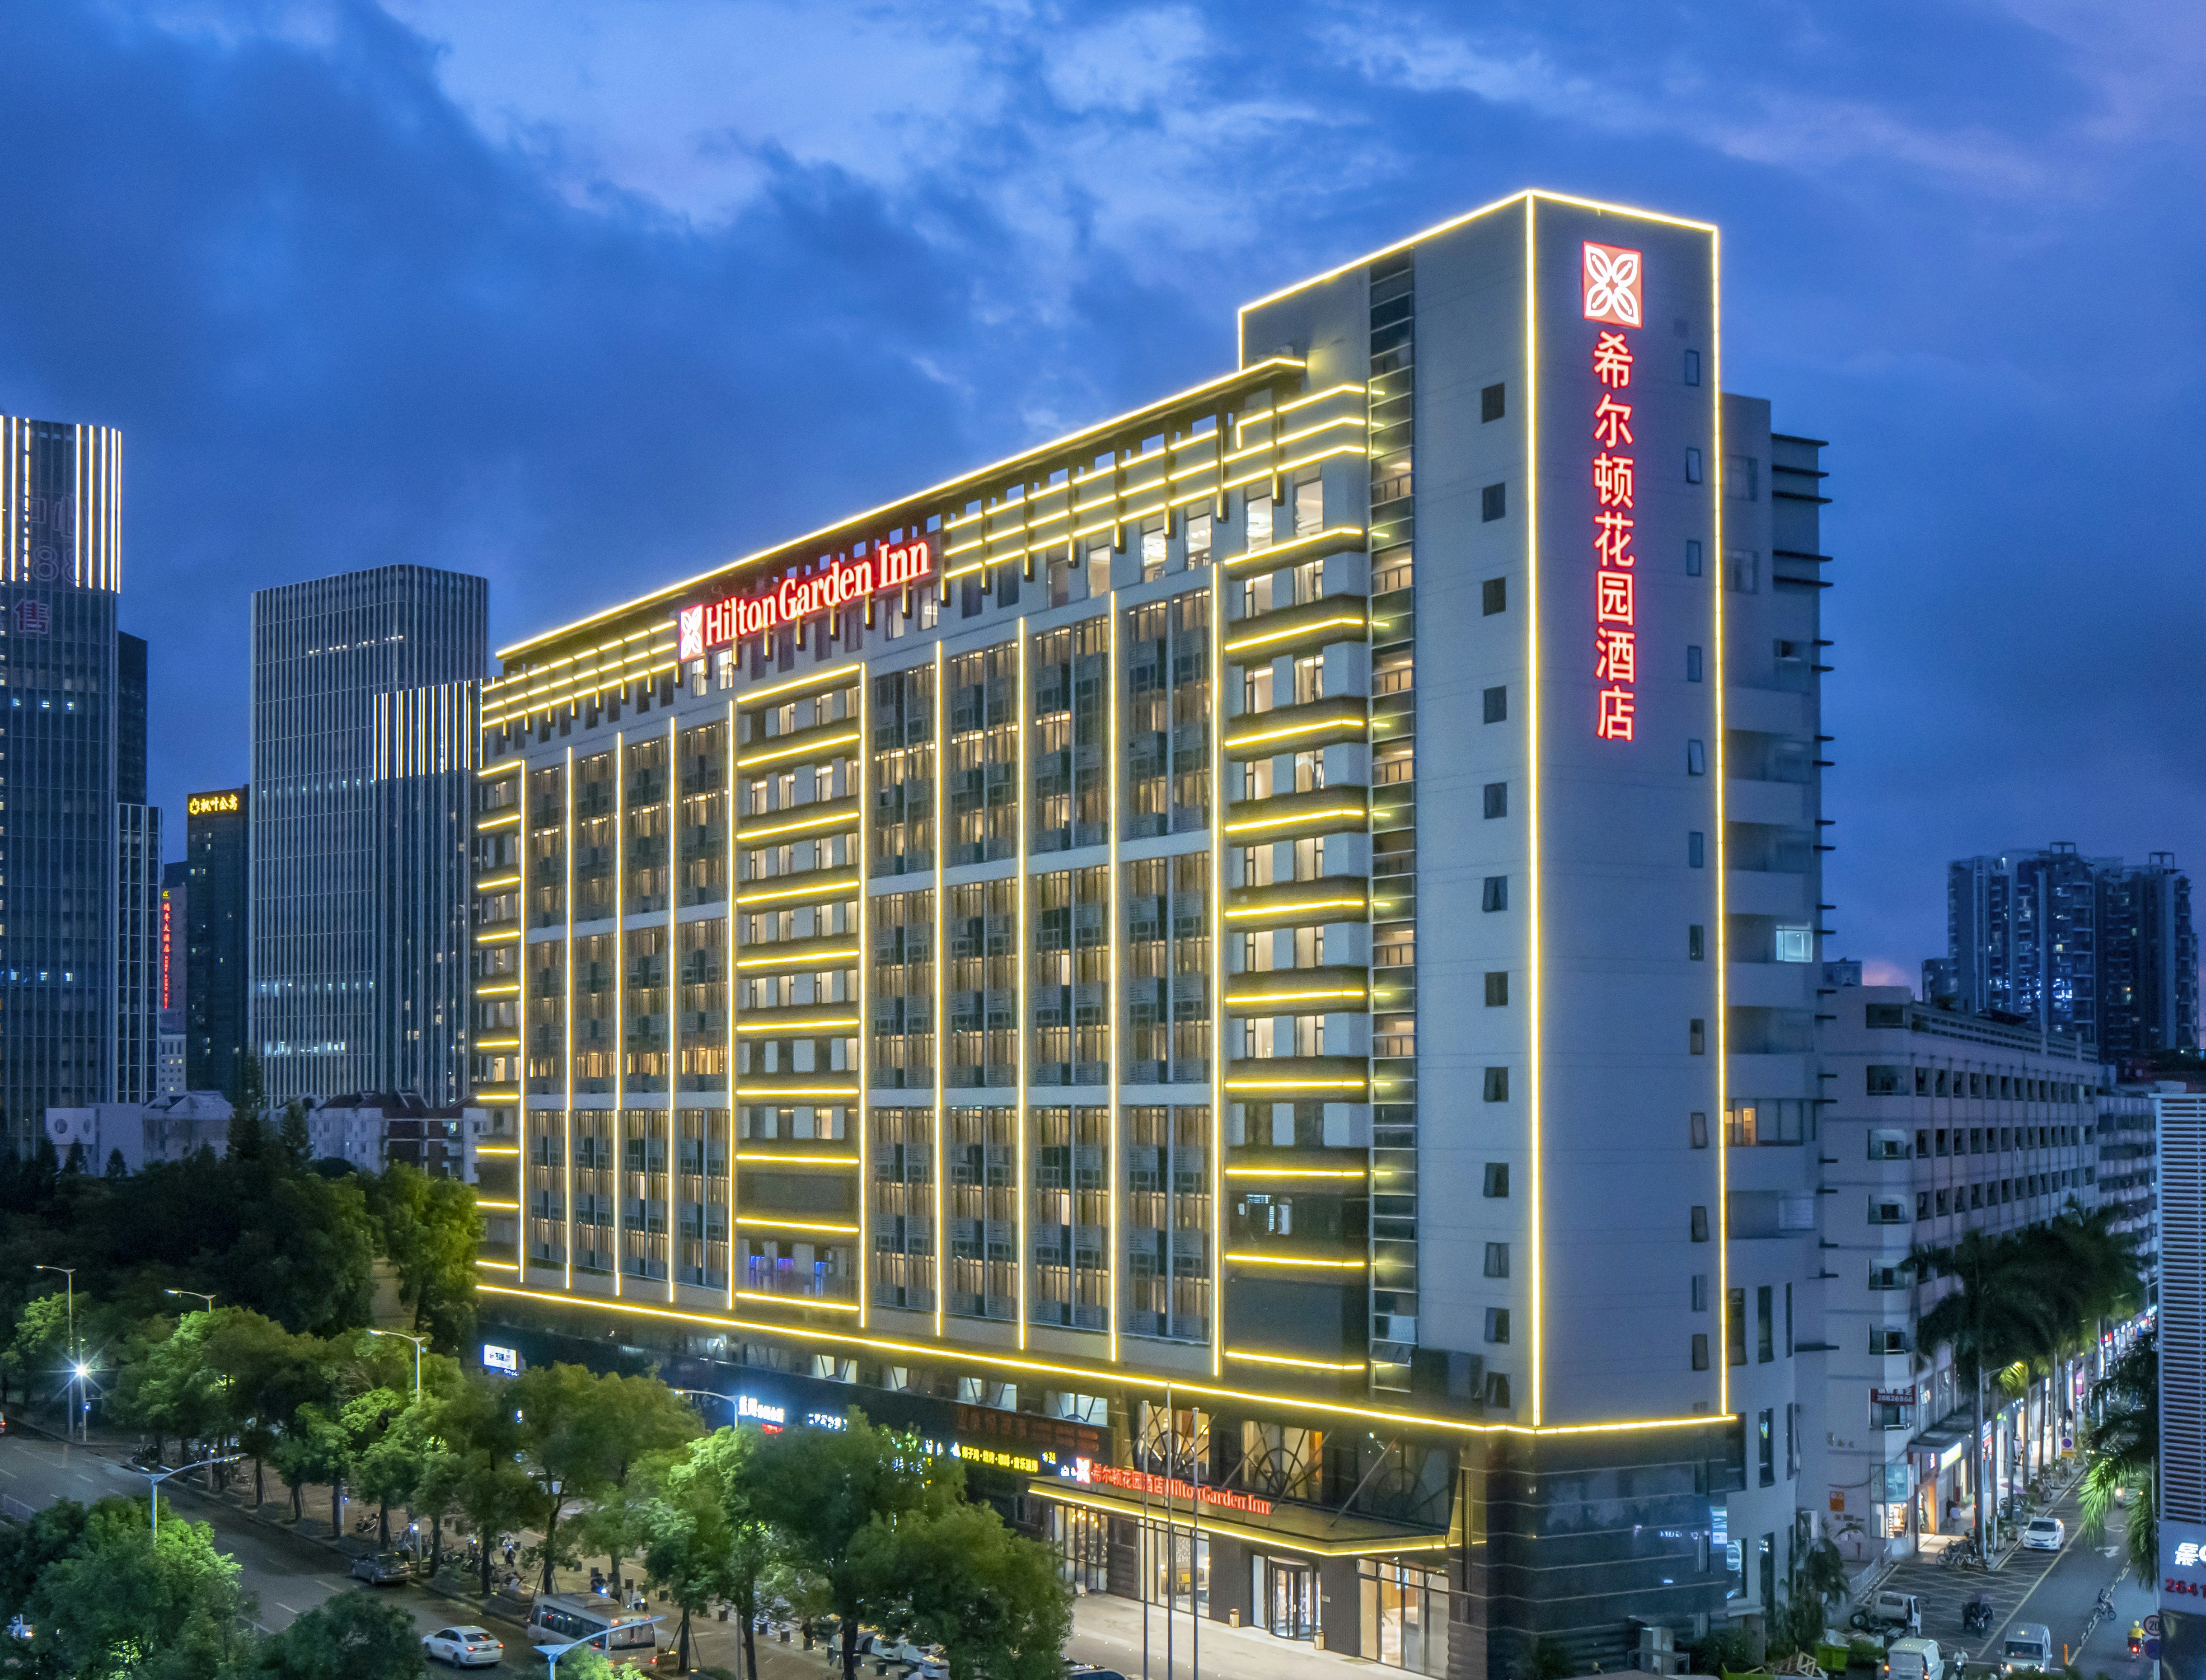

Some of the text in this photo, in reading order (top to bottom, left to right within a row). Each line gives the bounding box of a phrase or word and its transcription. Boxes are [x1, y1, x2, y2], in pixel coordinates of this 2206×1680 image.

[1593, 330, 1634, 741] 希尔顿花园酒店
[705, 541, 932, 647] Hilton Garden Inn
[1092, 1462, 1164, 1495] 希尔顿花园酒店
[1202, 1486, 1246, 1510] Garden
[1247, 1494, 1271, 1515] Inn
